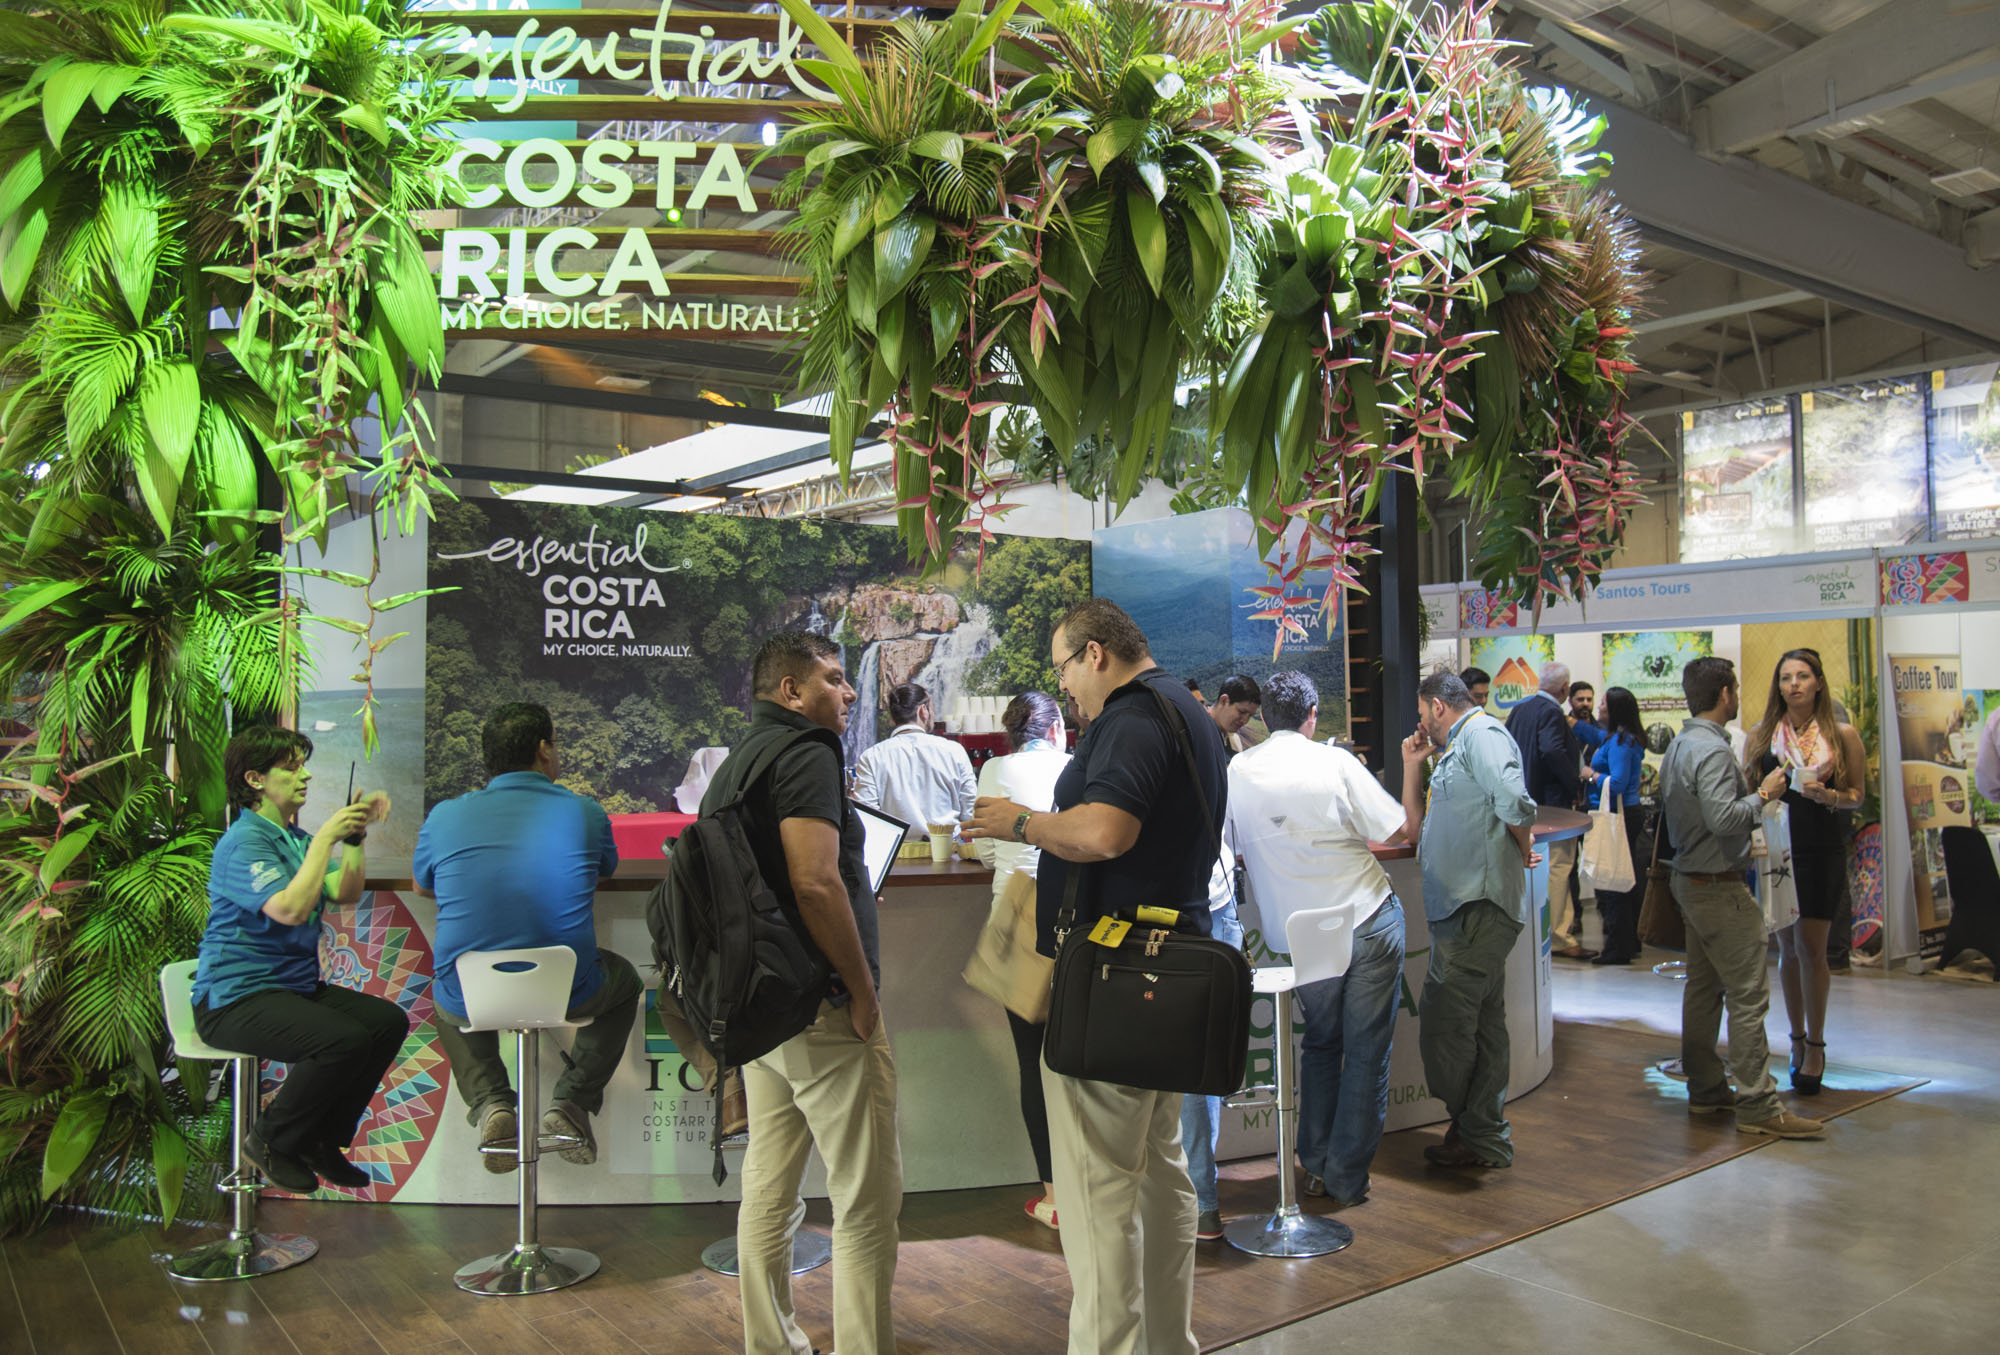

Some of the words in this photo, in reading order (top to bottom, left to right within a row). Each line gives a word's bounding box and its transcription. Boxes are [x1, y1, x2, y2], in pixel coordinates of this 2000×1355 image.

[441, 138, 758, 212] COSTA
[440, 227, 671, 298] RICA
[441, 302, 486, 330] MY
[500, 302, 631, 332] CHOICE,
[437, 523, 680, 576] essential
[543, 575, 666, 607] COSTA
[1596, 586, 1646, 600] Santos
[1650, 583, 1691, 596] Tours
[1820, 581, 1855, 592] COSTA
[1820, 591, 1846, 601] RICA
[545, 609, 635, 639] RICA
[543, 644, 564, 656] MY
[567, 644, 618, 657] CHOICE,
[622, 644, 692, 657] NATURALLY.
[1893, 665, 1932, 691] Coffee
[1933, 665, 1958, 690] Tour
[1243, 1109, 1273, 1131] MY
[643, 1131, 662, 1142] DE
